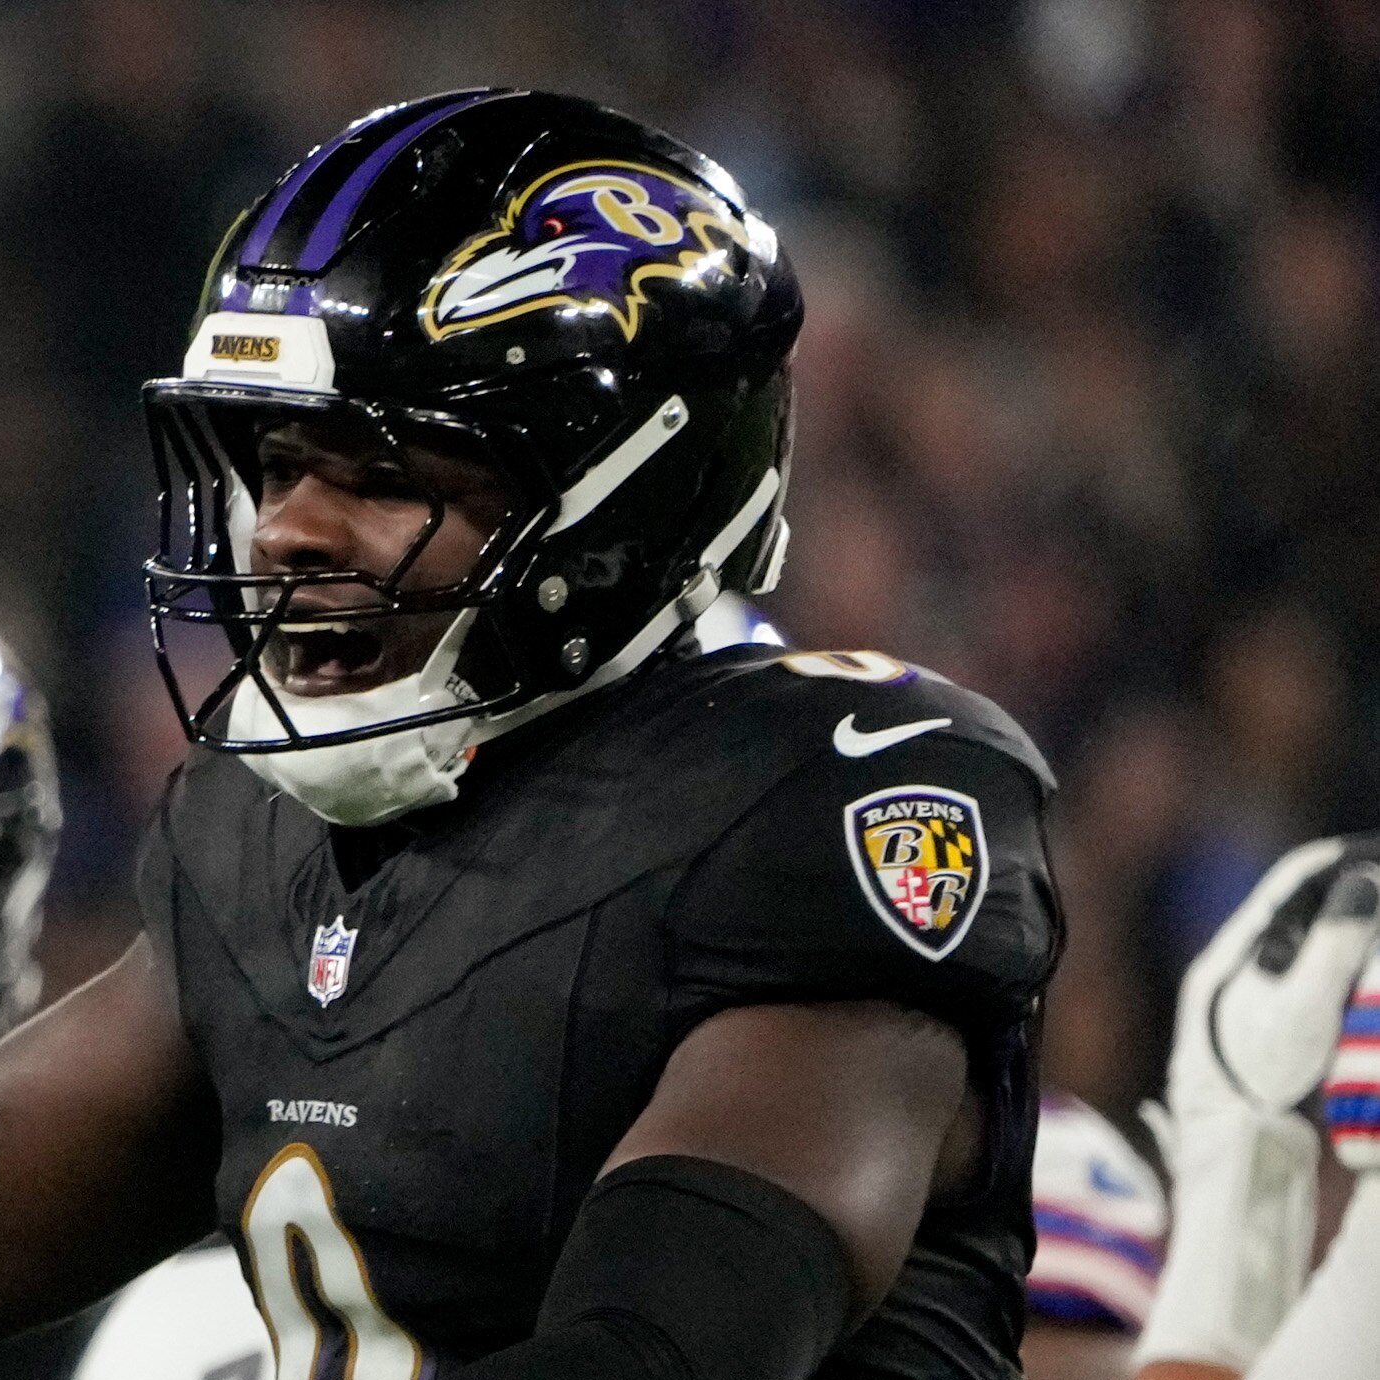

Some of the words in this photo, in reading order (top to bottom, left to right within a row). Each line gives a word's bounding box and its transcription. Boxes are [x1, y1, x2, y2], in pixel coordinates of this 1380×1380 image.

[862, 801, 964, 827] RAVENS
[870, 825, 923, 866] B
[266, 1099, 358, 1128] RAVENS
